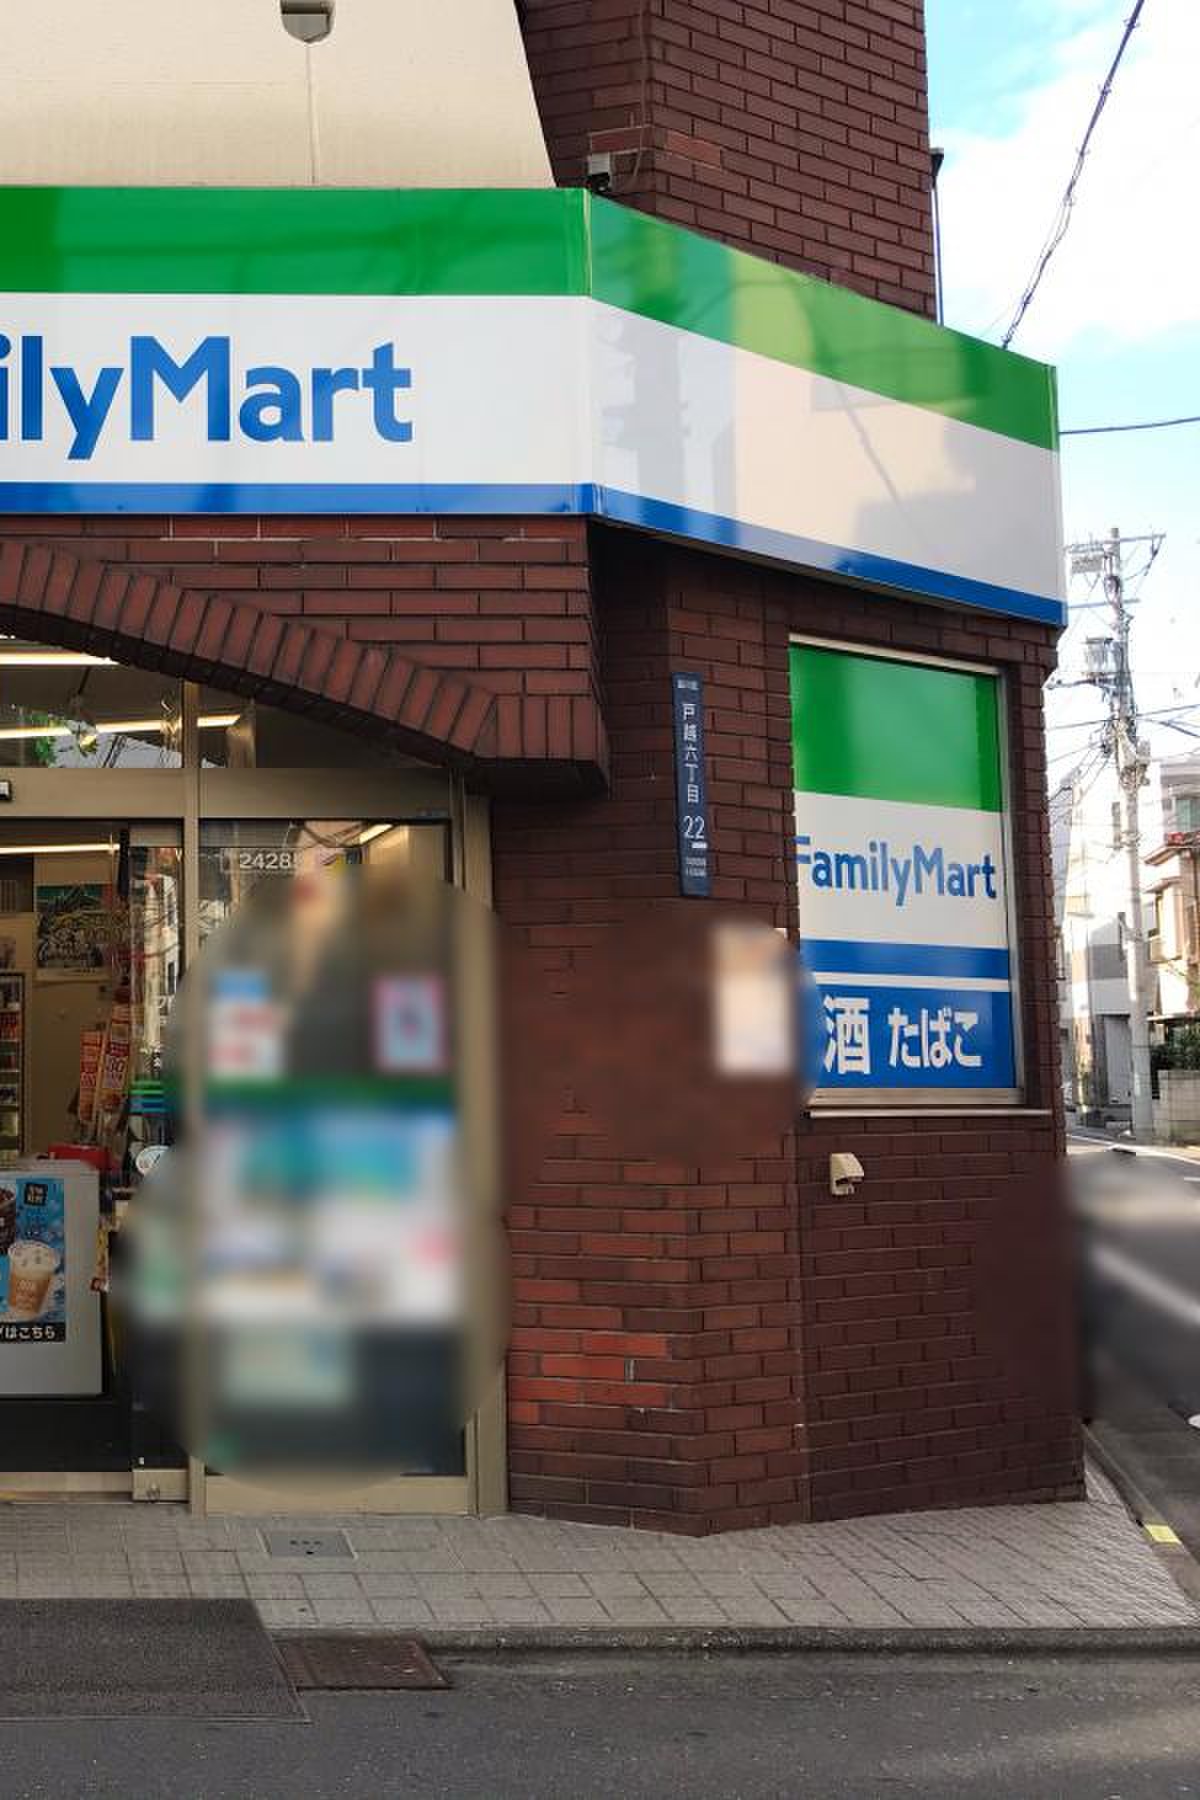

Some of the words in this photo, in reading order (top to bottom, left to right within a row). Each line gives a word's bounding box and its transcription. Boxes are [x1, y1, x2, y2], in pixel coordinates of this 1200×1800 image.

[682, 703, 699, 804] 戸越六丁目
[683, 815, 705, 840] 22
[823, 995, 870, 1074] 酒
[888, 1007, 982, 1068] たばこ
